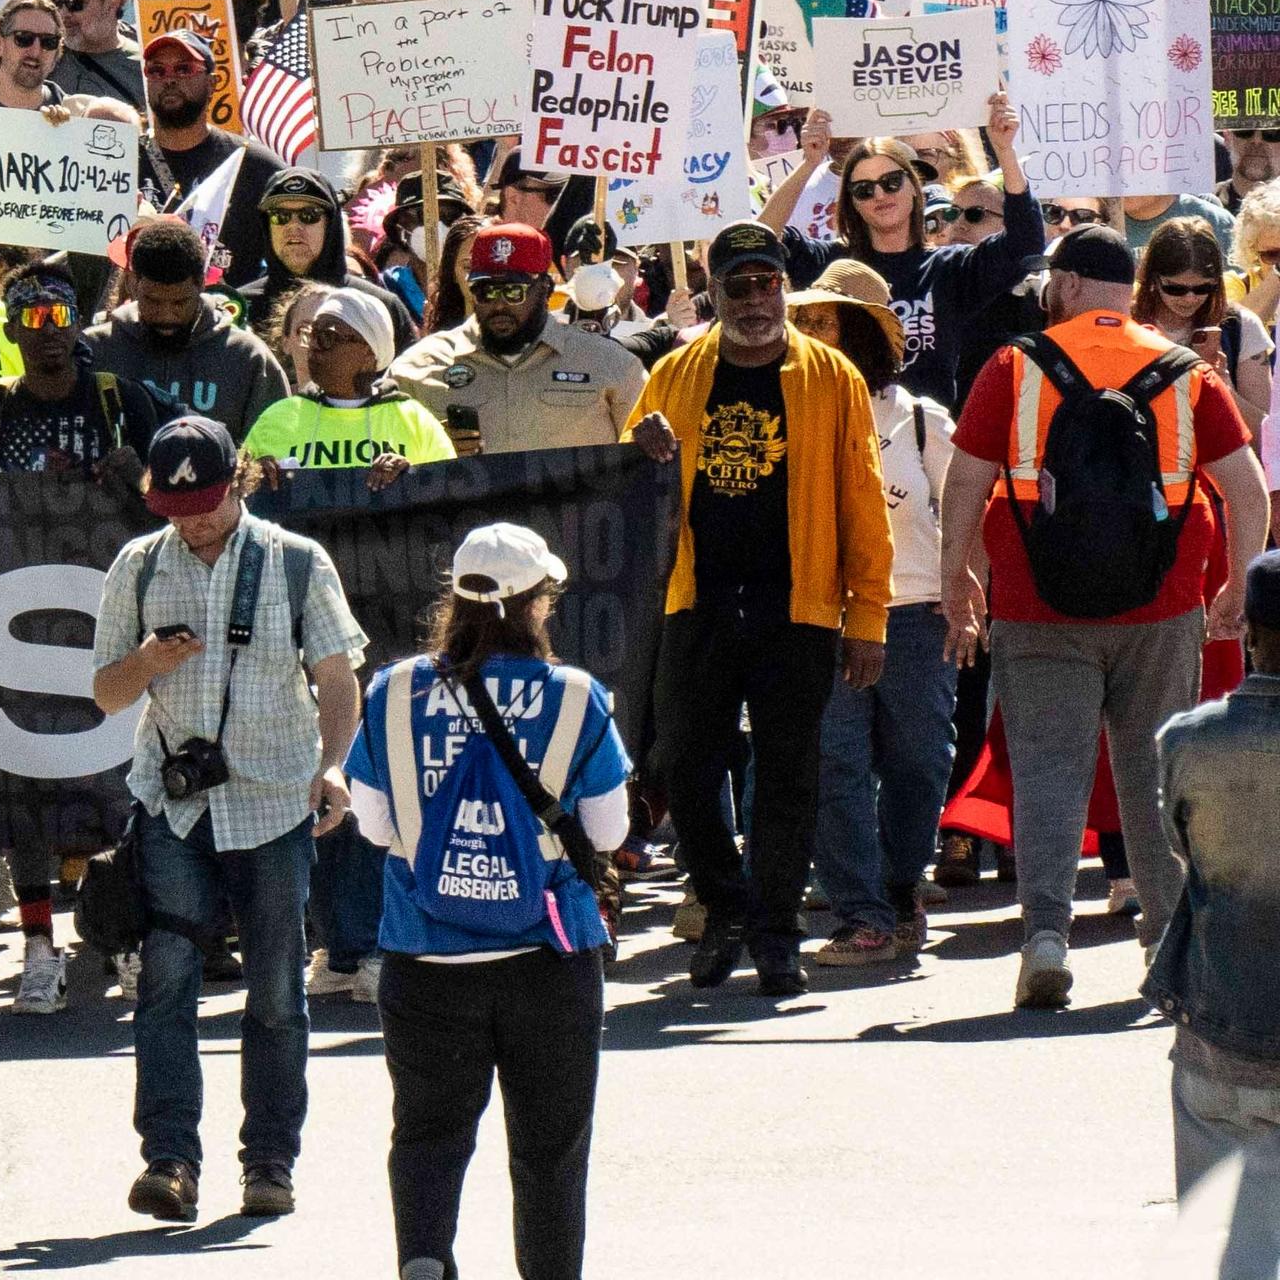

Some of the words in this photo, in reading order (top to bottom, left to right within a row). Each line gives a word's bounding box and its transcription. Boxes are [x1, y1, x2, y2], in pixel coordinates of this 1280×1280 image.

[562, 25, 655, 76] Felon
[852, 38, 961, 68] JASON
[852, 62, 963, 87] ESTEVES
[532, 70, 670, 132] Pedophile
[852, 81, 963, 102] GOVERNOR
[1020, 103, 1115, 143] NEEDS
[1129, 96, 1203, 141] YOUR
[536, 117, 662, 176] Fascist
[1023, 143, 1191, 183] COURAGE
[58, 155, 130, 194] 10:42-45
[707, 465, 758, 480] CBTU
[709, 480, 758, 490] METRO
[454, 799, 505, 836] ACLU
[442, 851, 515, 878] LEGAL
[439, 874, 519, 901] OBSERVER
